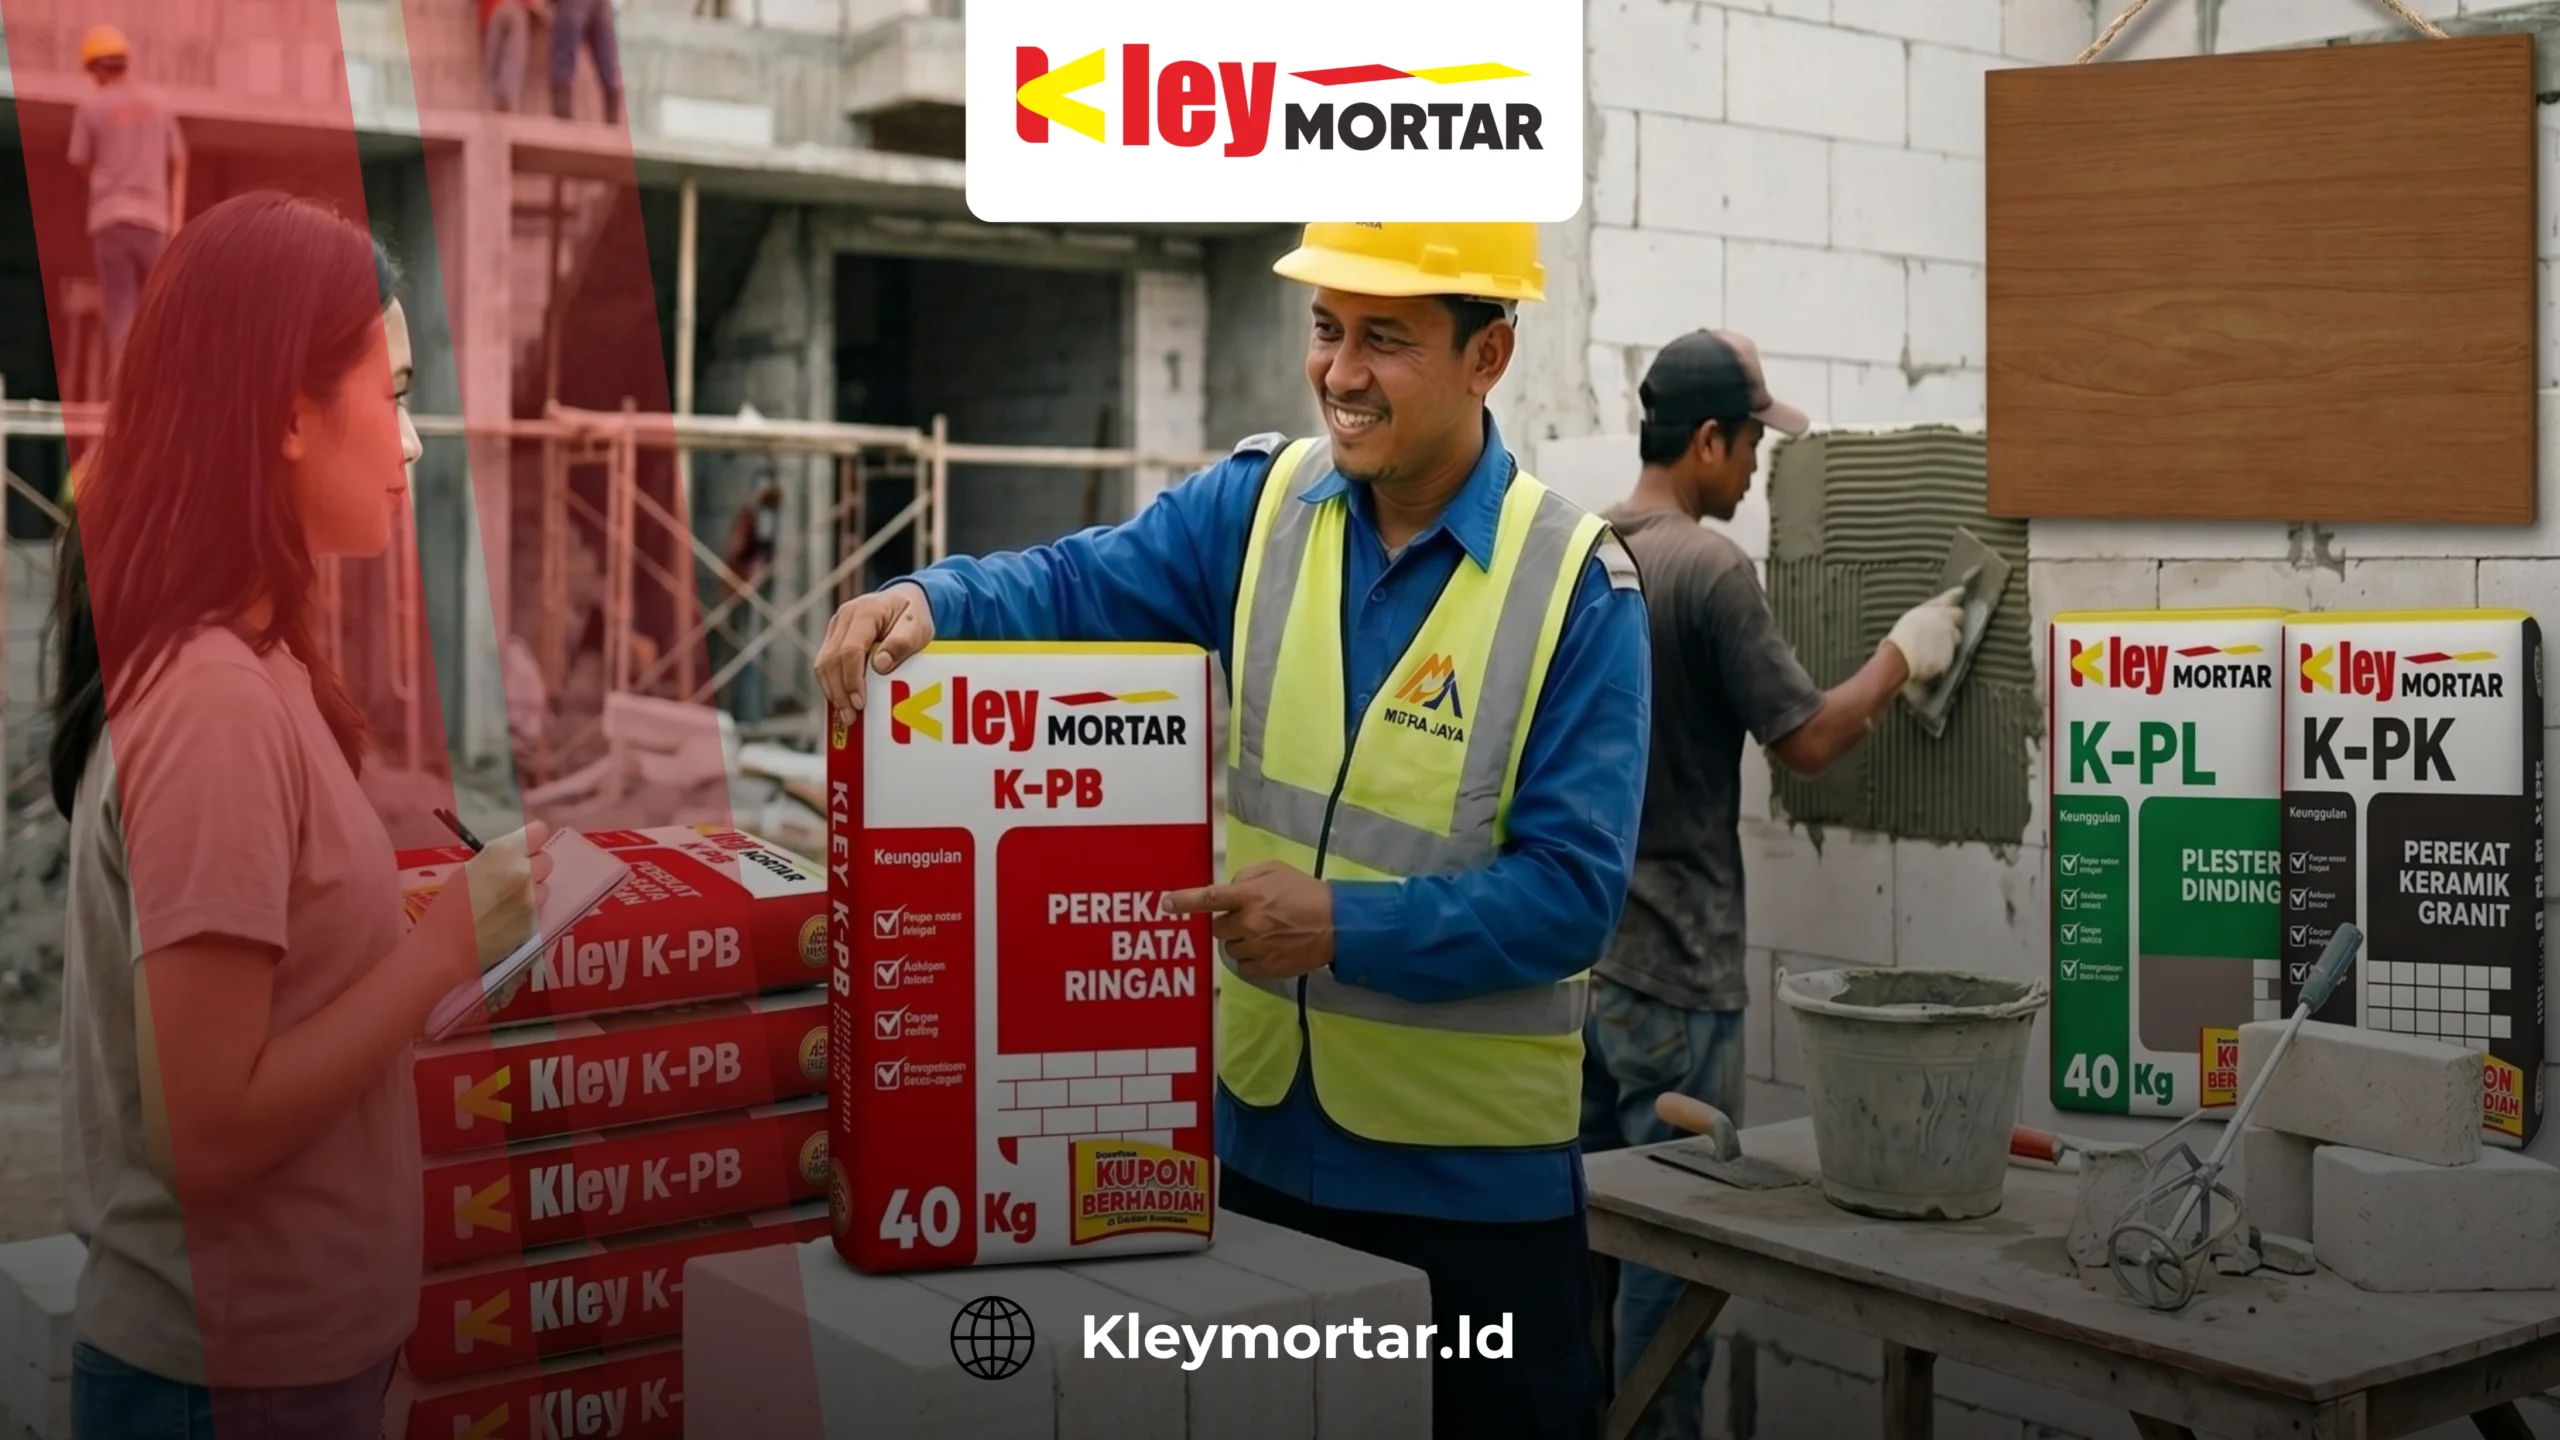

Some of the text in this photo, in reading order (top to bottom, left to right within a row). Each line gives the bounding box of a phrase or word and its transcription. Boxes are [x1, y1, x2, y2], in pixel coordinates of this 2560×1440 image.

[2069, 636, 2272, 695] Kley MORTAR
[2300, 641, 2503, 702] Kley MORTAR
[890, 676, 1039, 752] Kley
[1048, 715, 1187, 746] MORTAR
[1430, 723, 1464, 743] JAYA
[2070, 721, 2216, 785] K-PL
[2304, 716, 2456, 781] K-PK
[994, 768, 1104, 810] K-PB
[832, 780, 848, 888] KLEY
[2059, 809, 2121, 825] Keunggulan
[2289, 806, 2347, 821] Keunggulan
[873, 848, 962, 868] Keunggulan
[2182, 848, 2281, 874] PLESTER
[2404, 840, 2511, 867] PEREKAT
[2182, 877, 2281, 904] DINDING
[2400, 869, 2511, 898] KERAMIK
[1048, 890, 1192, 925] PEREKA
[2418, 900, 2511, 927] GRANIT
[530, 934, 630, 993] Kley
[641, 926, 741, 978] K-PB
[832, 899, 850, 997] K-PB
[1112, 929, 1196, 961] BATA
[1065, 968, 1195, 1001] RINGAN
[529, 1054, 630, 1113] Kley
[641, 1042, 742, 1095] K-PB
[2063, 1053, 2174, 1106] 40 Kg
[529, 1162, 630, 1222] Kley
[642, 1147, 742, 1202] K-PB
[1096, 1158, 1197, 1188] KUPON
[879, 1185, 1037, 1249] 40 Kg
[1082, 1189, 1205, 1216] BERHADIAH
[529, 1275, 629, 1333] Kley
[641, 1268, 683, 1310] K-
[529, 1387, 628, 1440] Kley
[640, 1378, 683, 1423] K-
